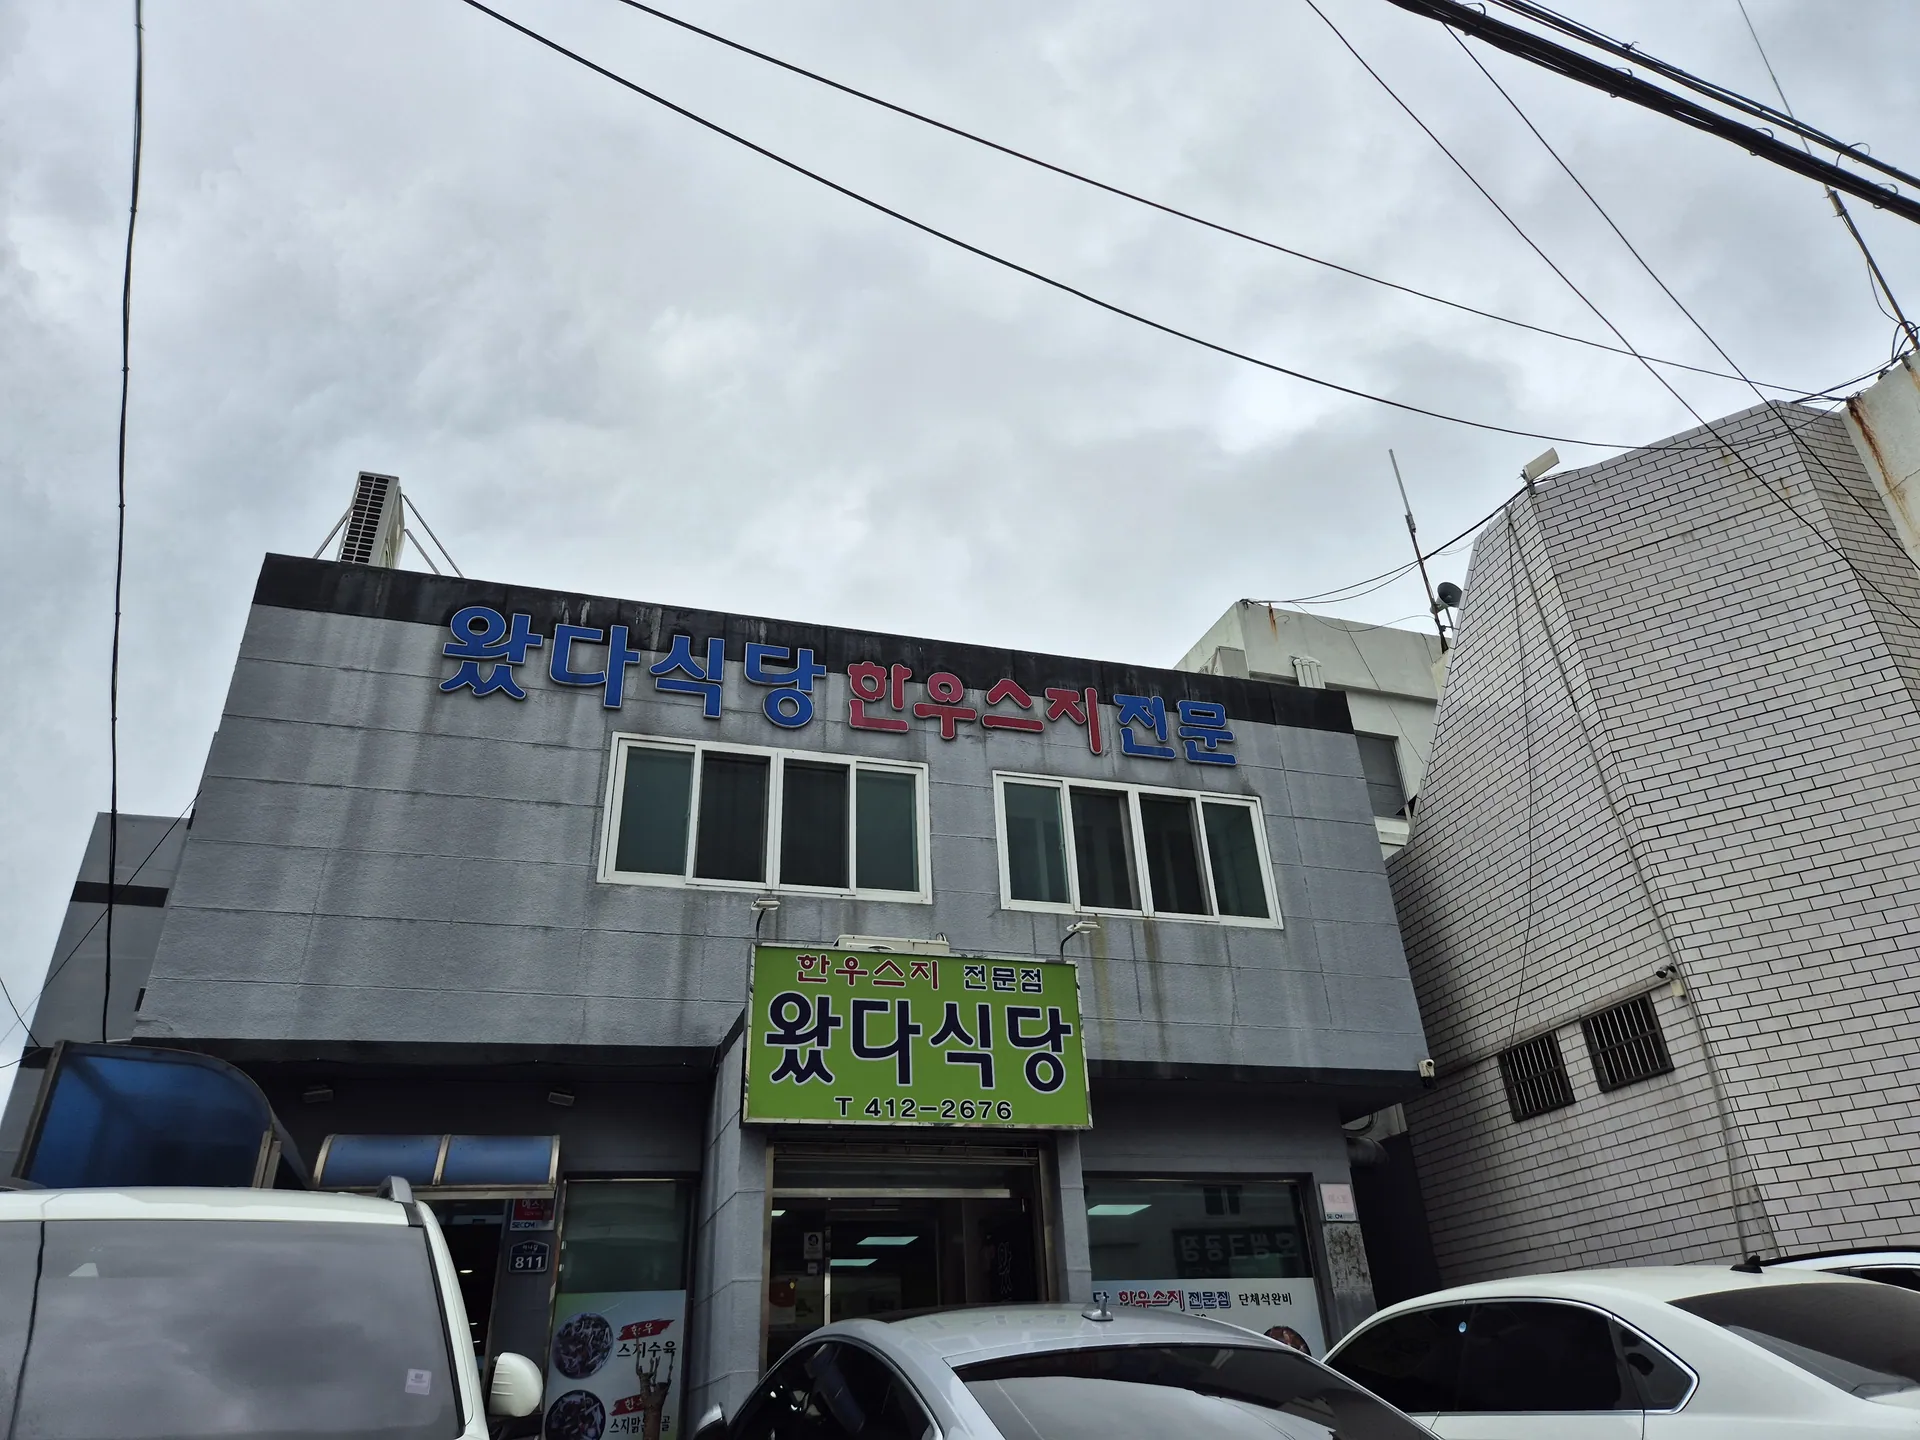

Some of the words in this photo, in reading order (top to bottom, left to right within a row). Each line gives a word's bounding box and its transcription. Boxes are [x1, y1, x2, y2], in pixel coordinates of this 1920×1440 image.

[439, 606, 827, 729] 왔다식당
[847, 661, 1103, 755] 한우스지
[1113, 693, 1238, 766] 전문
[797, 954, 939, 990] 한우스지
[964, 964, 1043, 994] 전문점
[764, 991, 1074, 1094] 왔다식당
[834, 1096, 854, 1117] T
[864, 1097, 1013, 1120] 412-2676
[515, 1255, 542, 1269] 811
[1187, 1290, 1232, 1309] 전문점
[1238, 1291, 1292, 1307] 단체석완비
[616, 1341, 677, 1358] 스지수육
[609, 1415, 671, 1434] 스지맑골
